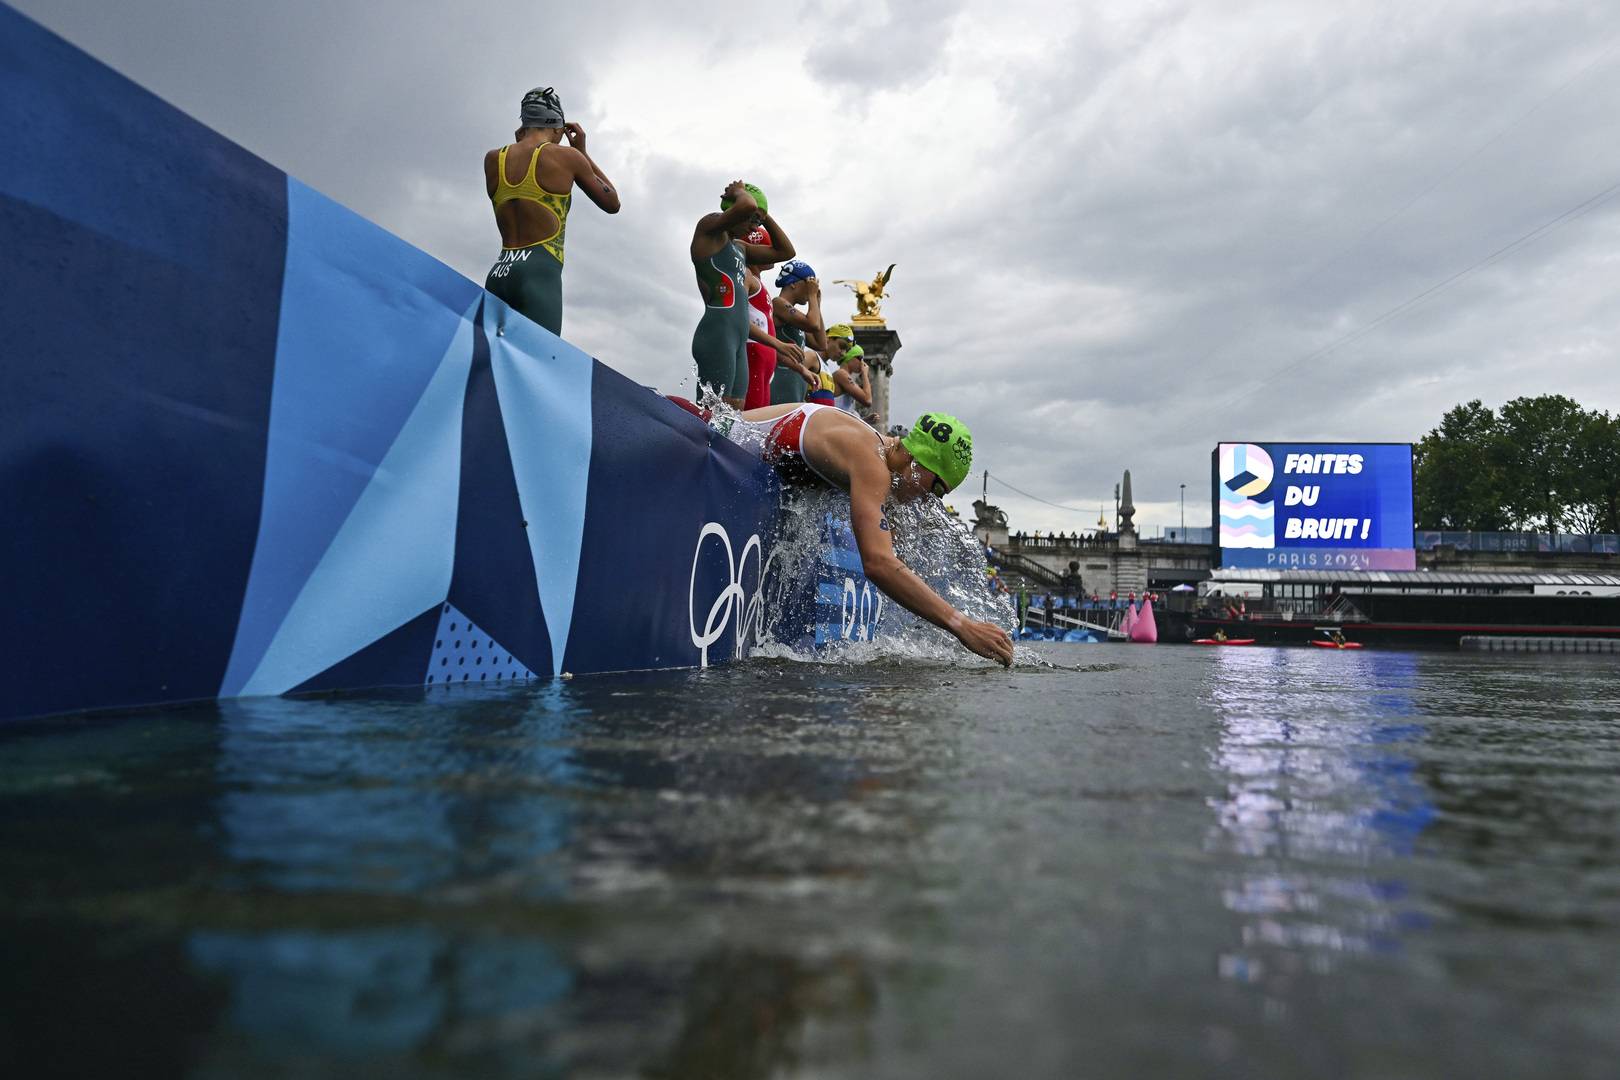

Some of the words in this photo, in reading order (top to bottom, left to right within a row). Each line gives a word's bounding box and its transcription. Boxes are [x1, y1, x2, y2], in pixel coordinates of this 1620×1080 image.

[490, 263, 513, 278] AUS
[920, 415, 953, 443] 48
[1283, 453, 1364, 475] FAITES
[1284, 485, 1320, 506] DU
[1284, 518, 1358, 540] BRUIT
[1267, 553, 1318, 566] PARIS
[1324, 553, 1370, 566] 2024
